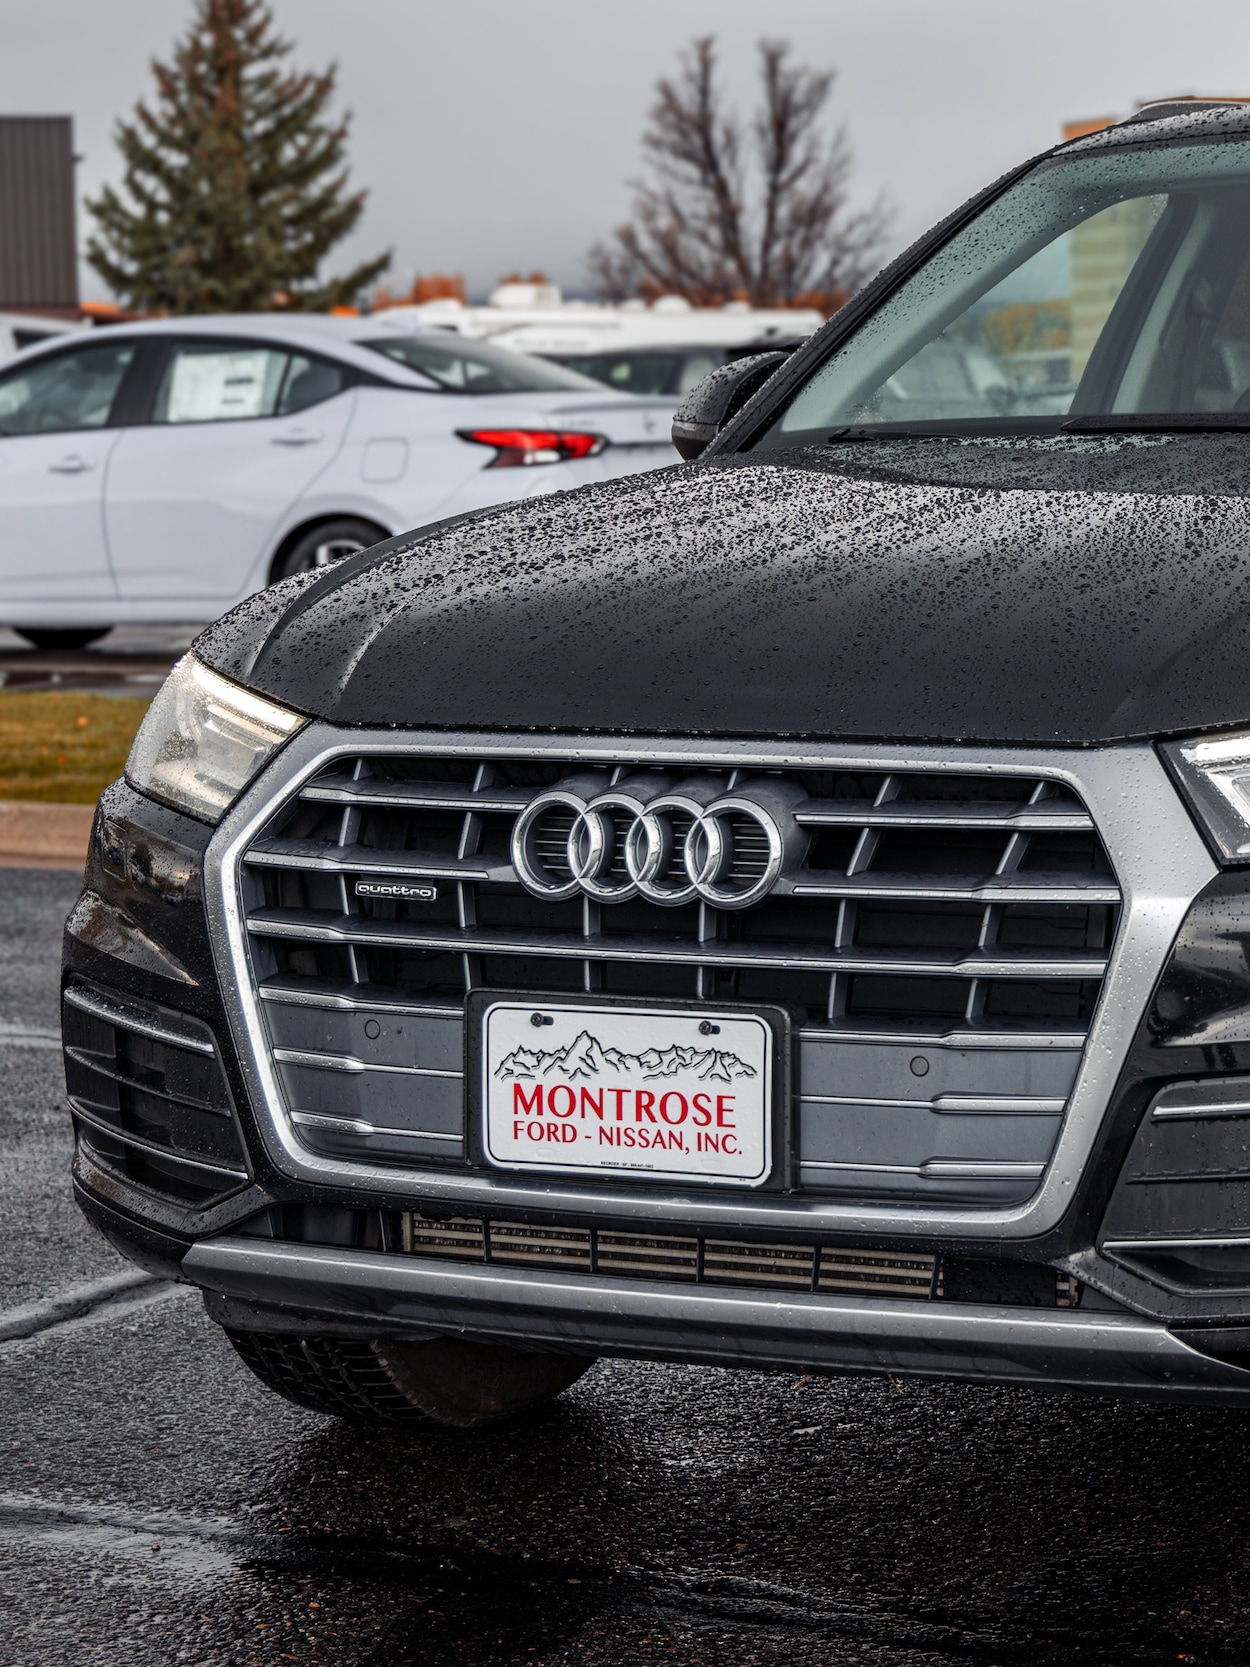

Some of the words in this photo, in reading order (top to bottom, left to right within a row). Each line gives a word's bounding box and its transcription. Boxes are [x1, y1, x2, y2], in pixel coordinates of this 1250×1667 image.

[358, 884, 432, 898] quattro
[513, 1083, 736, 1128] MONTROSE
[513, 1120, 577, 1143] FORD
[599, 1126, 690, 1155] NISSAN,
[697, 1132, 743, 1155] INC.
